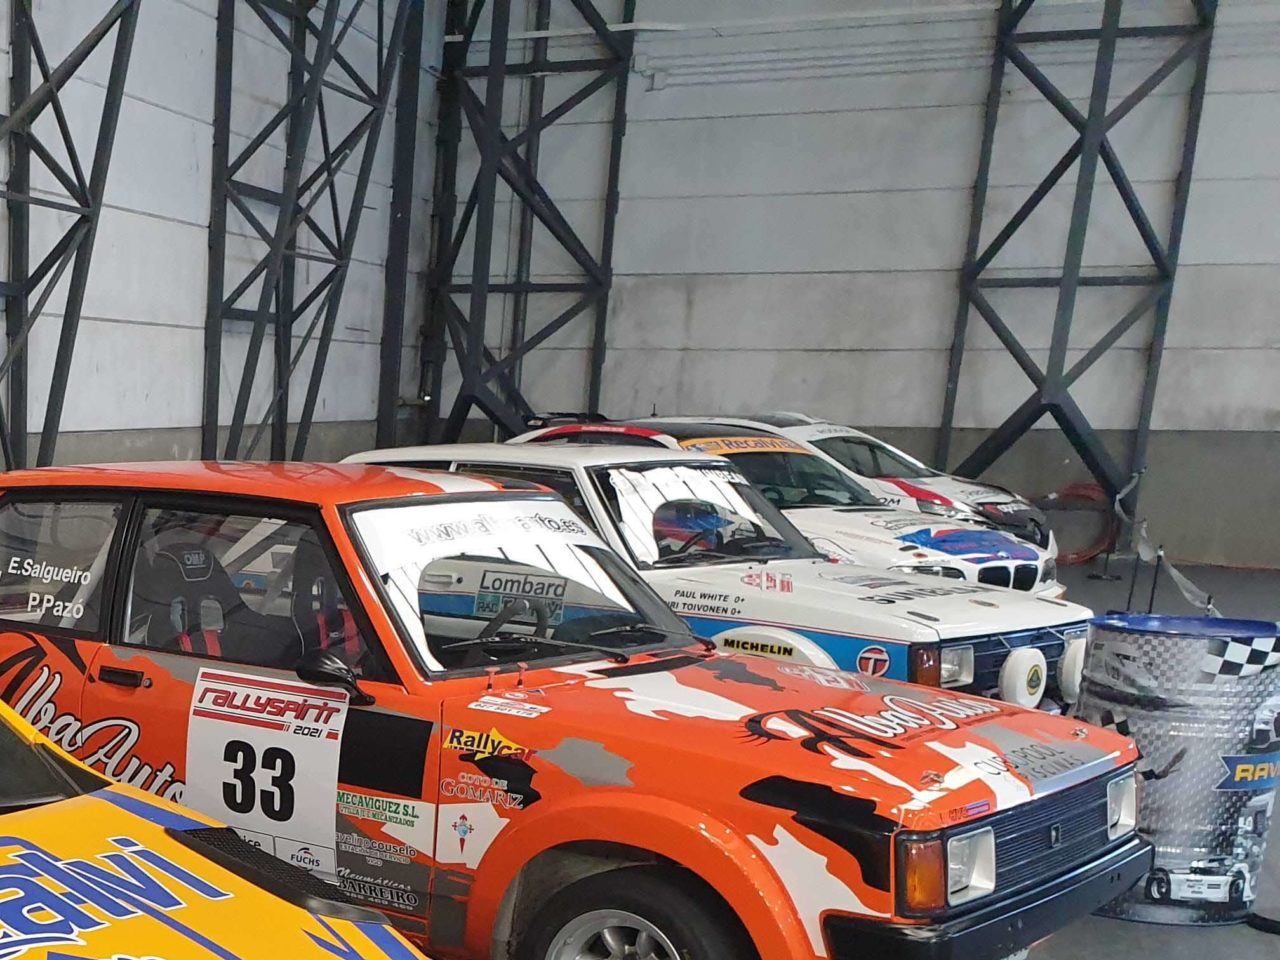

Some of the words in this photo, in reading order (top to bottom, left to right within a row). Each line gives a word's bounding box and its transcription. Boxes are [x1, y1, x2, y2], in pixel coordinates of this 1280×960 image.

[7, 556, 91, 584] E.Salgueiro
[480, 571, 568, 598] Lombard
[674, 589, 697, 599] PAUL
[699, 591, 730, 603] WHITE
[27, 592, 84, 619] P.Pazó
[681, 602, 729, 614] TOIVONEN
[723, 638, 794, 657] MICHELIN
[293, 724, 323, 738] 2021
[448, 728, 538, 761] Rallycar
[222, 739, 296, 822] 33
[440, 777, 524, 809] GOMARIZ
[458, 772, 491, 787] COTO
[491, 777, 508, 789] DE
[337, 791, 400, 815] MECAVIGUEZ
[402, 804, 420, 819] S.L.
[290, 852, 321, 867] FUCHS
[336, 866, 412, 891] Neumáticos
